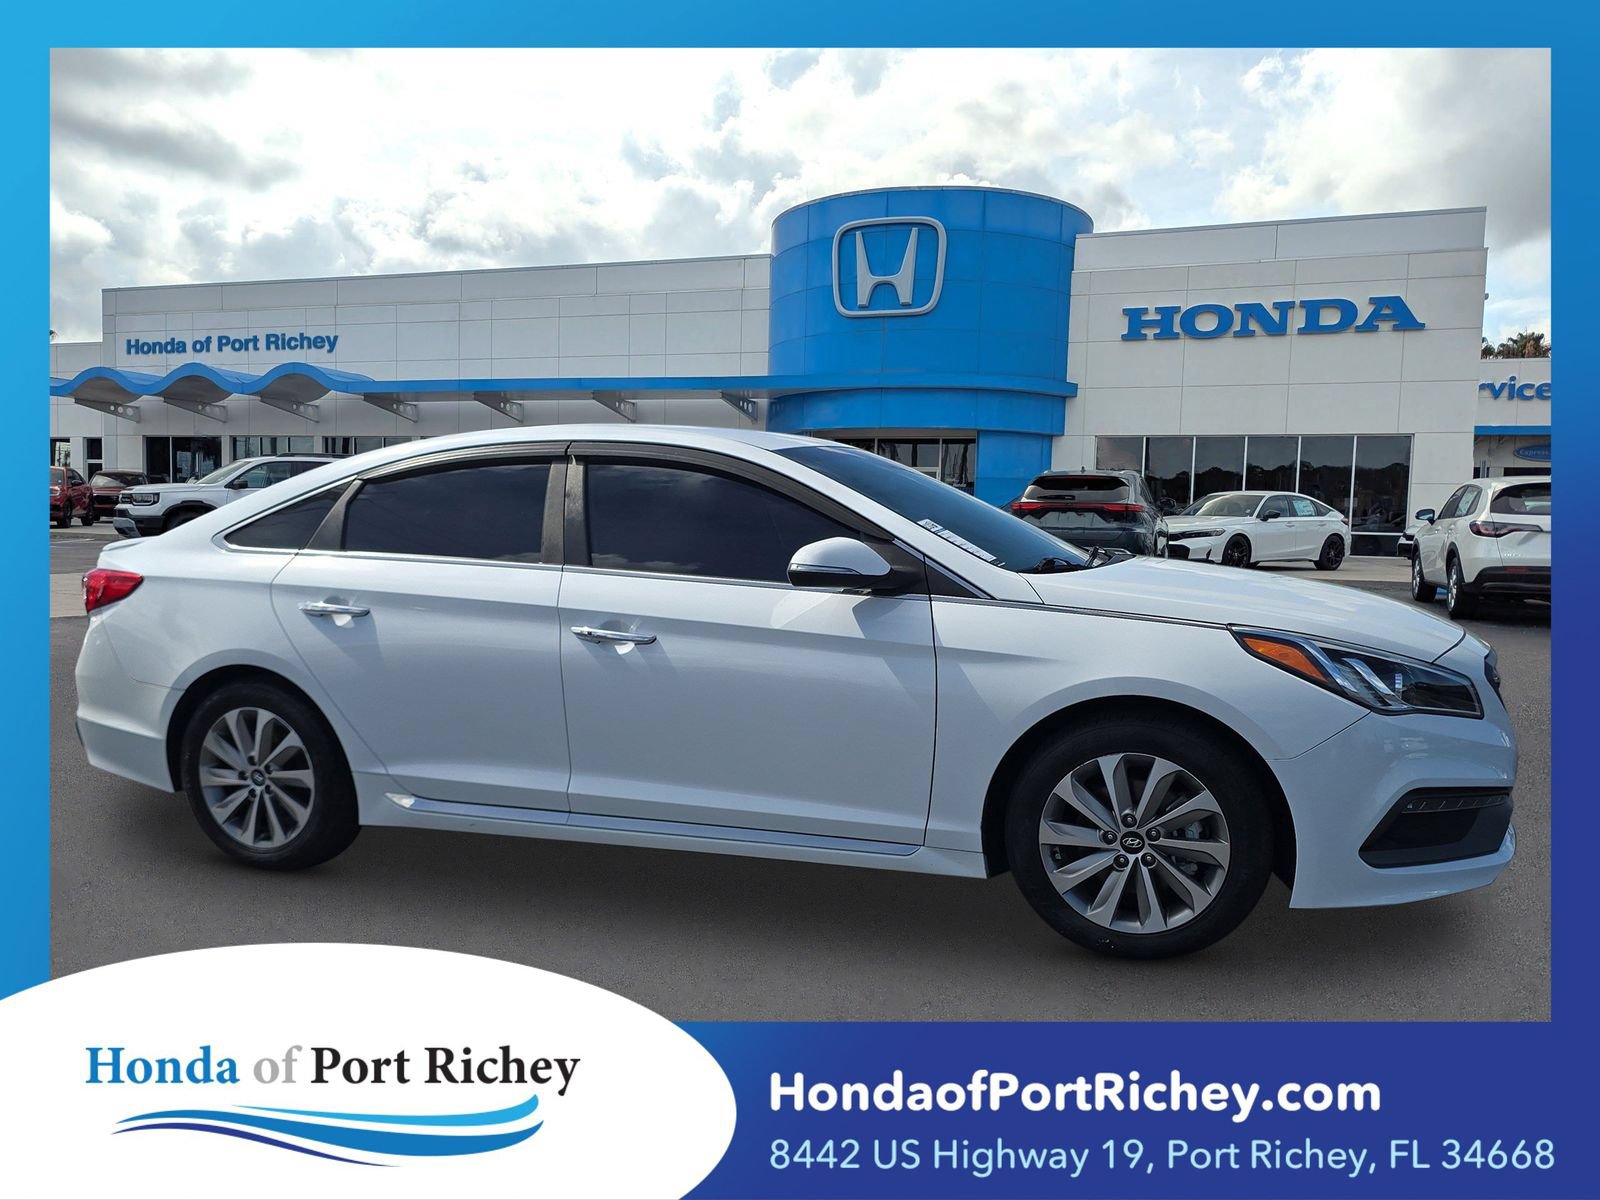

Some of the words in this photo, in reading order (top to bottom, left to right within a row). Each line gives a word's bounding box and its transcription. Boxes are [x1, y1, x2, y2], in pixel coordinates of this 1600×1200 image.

[1120, 295, 1426, 341] HONDA
[126, 337, 187, 355] Honda
[191, 336, 212, 353] of
[217, 334, 259, 352] Port
[265, 332, 338, 353] Richey
